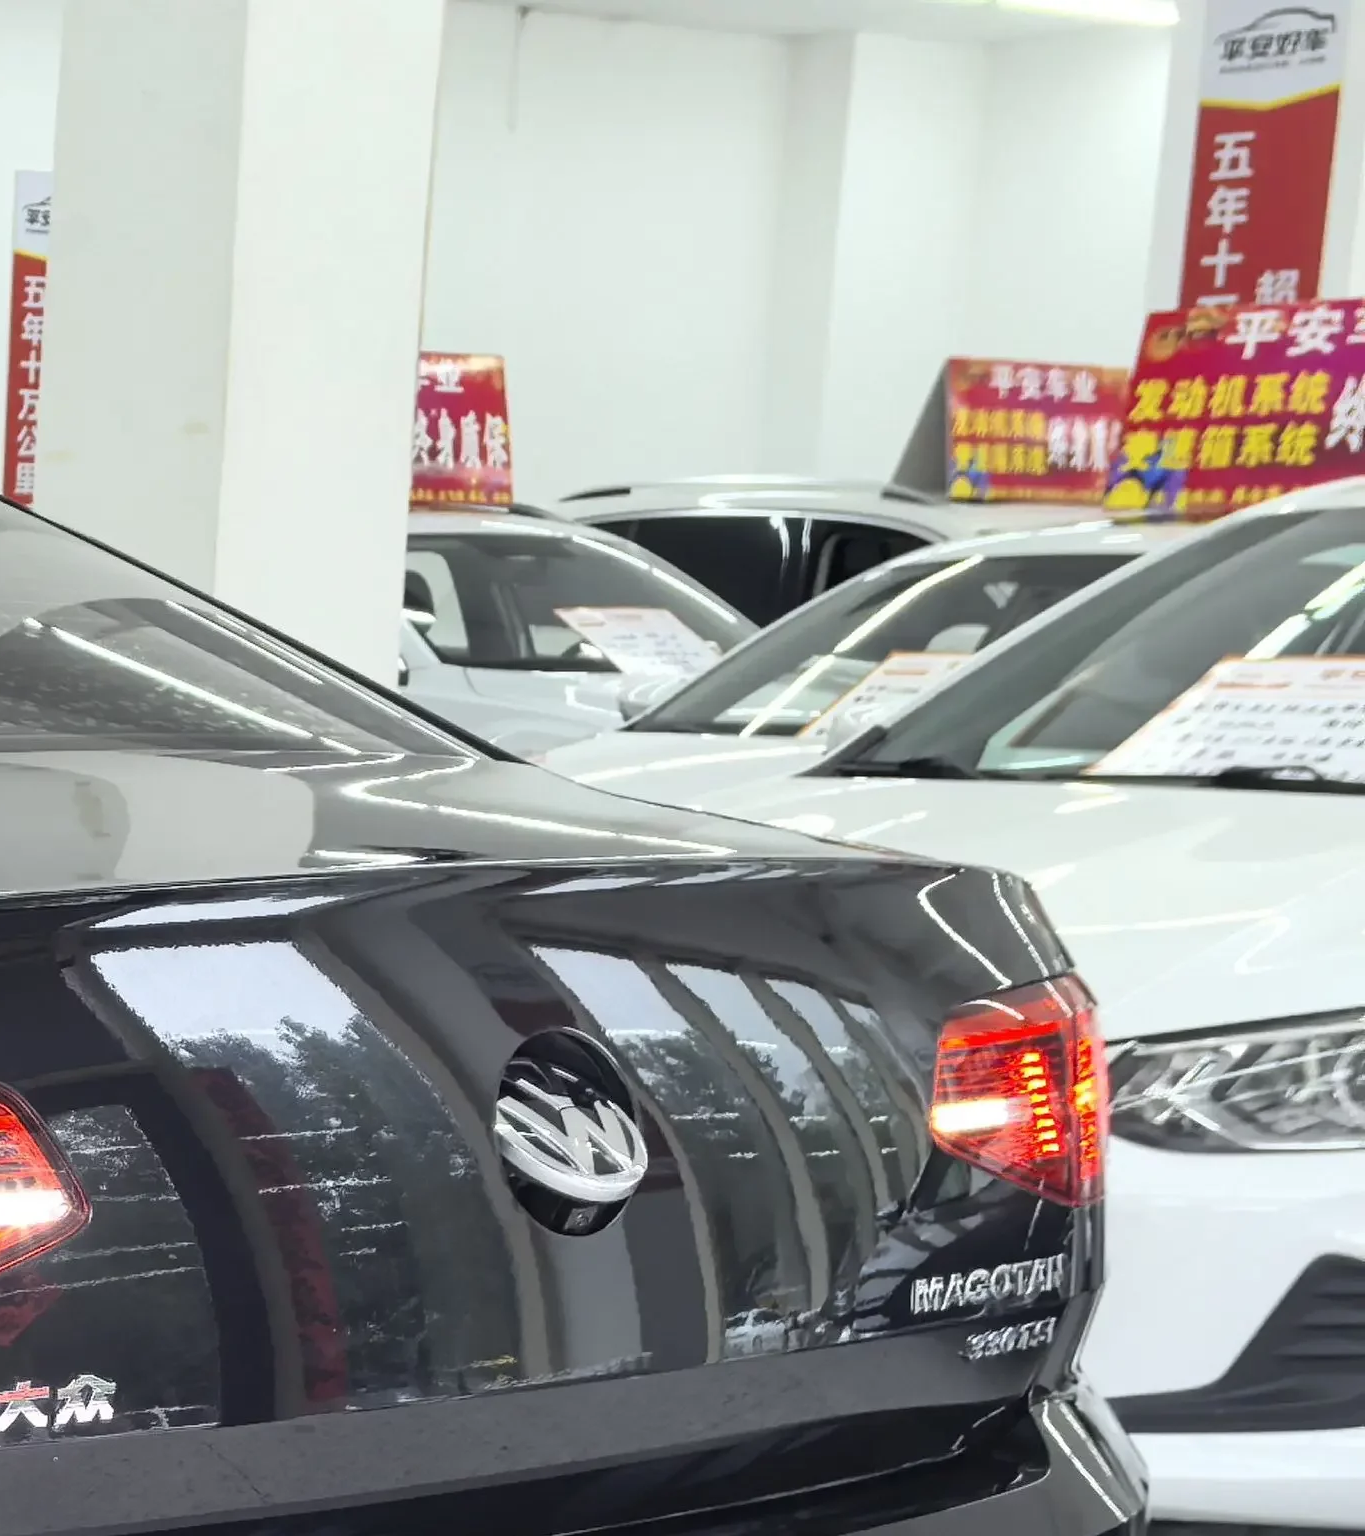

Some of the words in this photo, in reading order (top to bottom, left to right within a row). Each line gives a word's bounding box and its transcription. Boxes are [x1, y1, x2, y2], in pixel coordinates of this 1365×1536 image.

[1197, 131, 1256, 306] 五年十
[1129, 371, 1331, 422] 发动机系统
